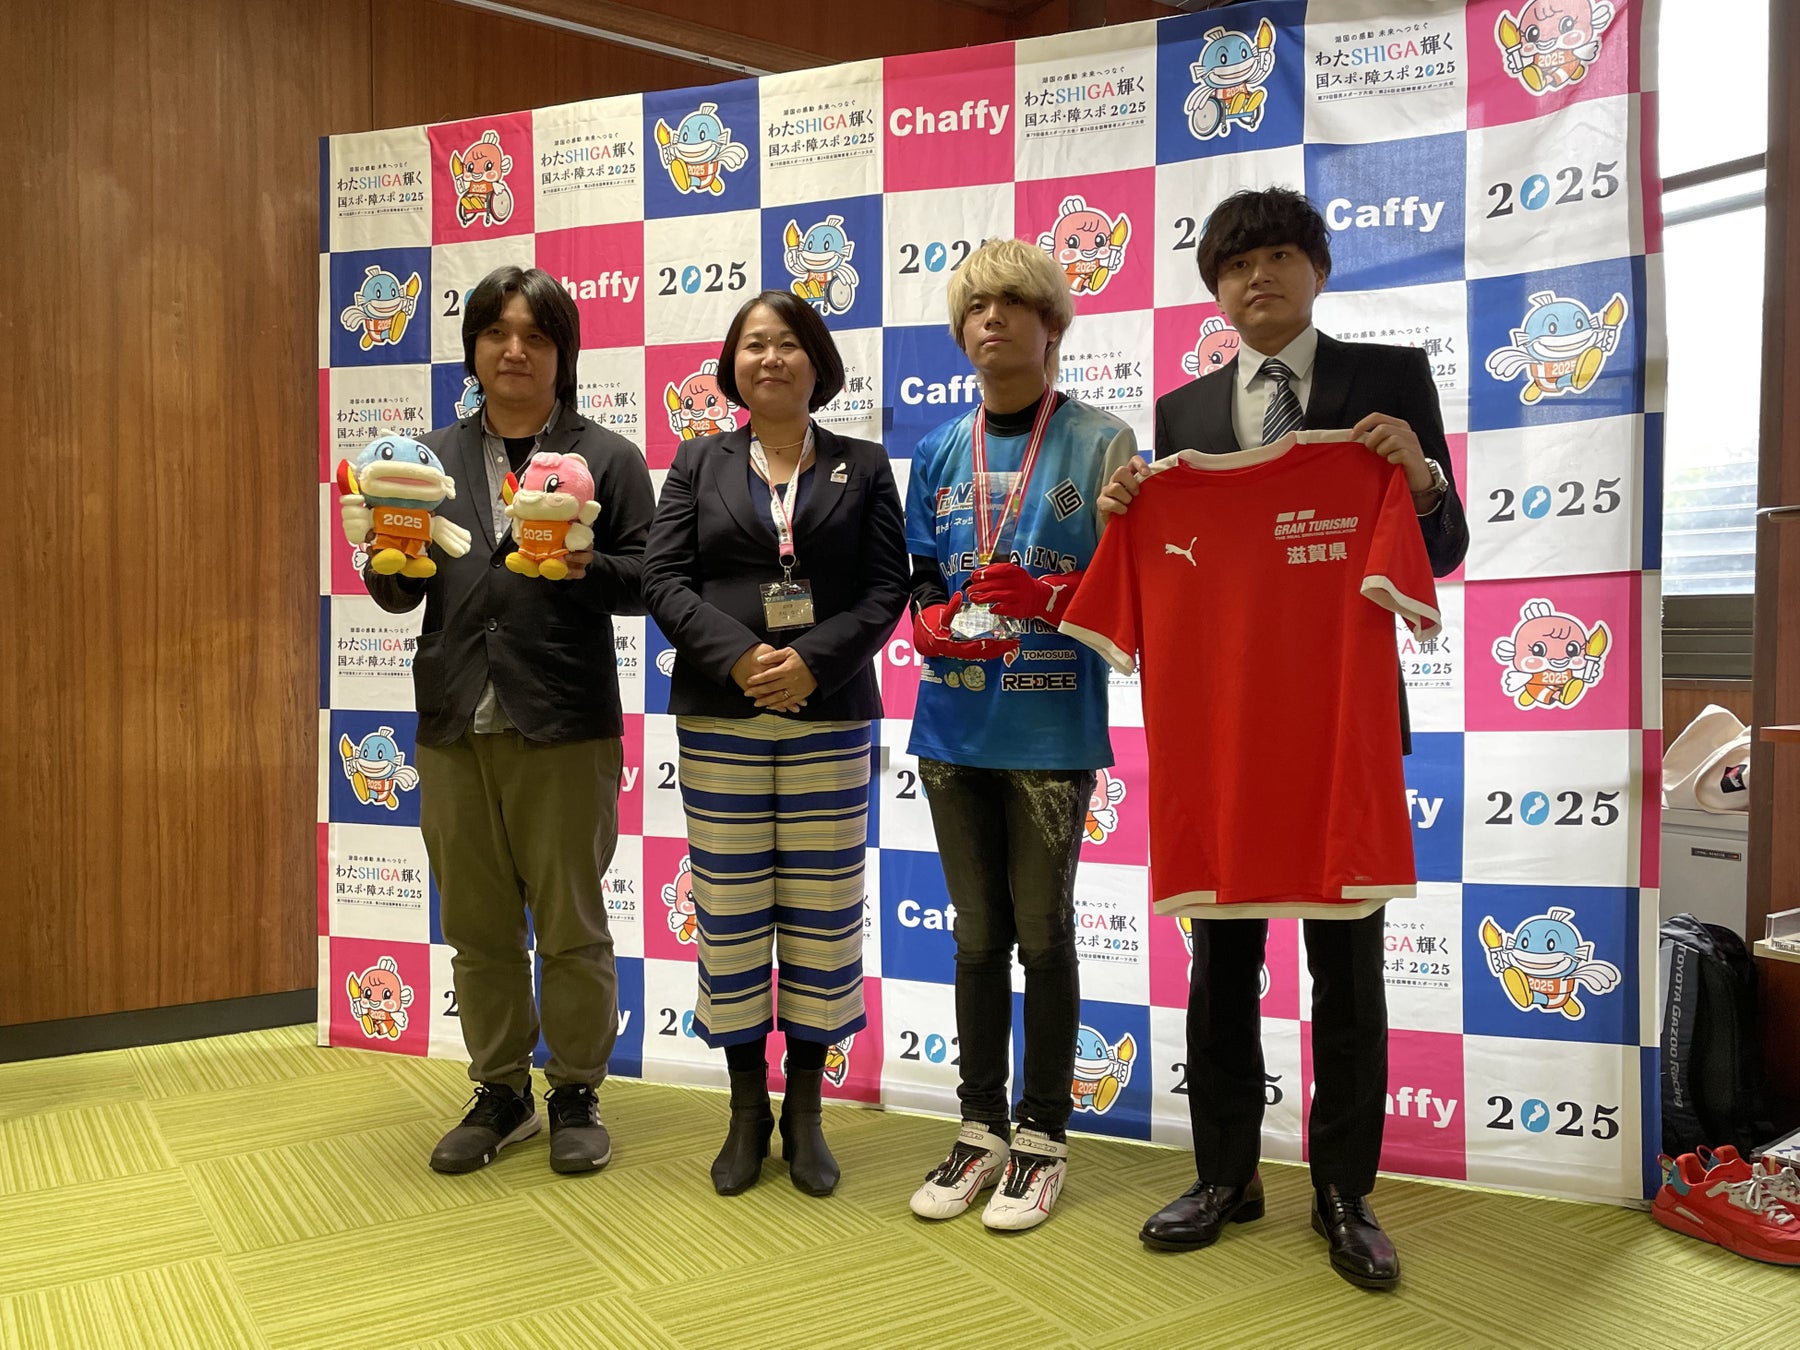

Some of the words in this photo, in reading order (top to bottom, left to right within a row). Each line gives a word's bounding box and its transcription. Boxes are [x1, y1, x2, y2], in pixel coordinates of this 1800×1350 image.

[1378, 22, 1428, 37] 未来へつなぐ
[1315, 32, 1453, 67] わたSHIGA輝く
[1538, 51, 1565, 67] 2025
[1081, 66, 1125, 78] 未来へつなぐ
[1414, 60, 1456, 79] 2025
[1024, 75, 1145, 107] わたSHIGA輝く
[1110, 101, 1147, 117] 2025
[768, 109, 874, 138] わたSHIGA輝く
[889, 99, 1010, 137] Chaffy
[843, 132, 875, 147] 2025
[541, 141, 635, 167] わたSHIGA輝く
[607, 163, 636, 176] 2025
[337, 171, 422, 191] わたSHIGA輝く
[398, 192, 424, 203] 2025
[1485, 159, 1620, 220] 2025
[1325, 195, 1445, 233] Caffy
[898, 240, 987, 275] 202
[1075, 261, 1097, 274] 2025
[560, 270, 640, 303] haffy
[657, 261, 747, 296] 2025
[1380, 326, 1430, 336] 未来へつなぐ
[1079, 351, 1122, 360] 未来へつなぐ
[1057, 362, 1142, 383] SHIGA輝く
[1108, 386, 1144, 399] 2025
[844, 399, 874, 412] 2025
[337, 406, 424, 423] わたSHIGA輝く
[609, 413, 638, 425] 2025
[1487, 477, 1621, 523] 2025
[383, 513, 423, 529] 2025
[1274, 522, 1306, 537] GRAN
[1308, 516, 1359, 532] TURISMO
[523, 528, 553, 542] 2025
[1286, 541, 1348, 565] 滋賀県
[337, 637, 417, 652] わたSHIGA輝
[617, 657, 637, 667] 025
[1022, 649, 1078, 663] TOMOSUBA
[1411, 663, 1453, 675] 2025
[1541, 670, 1569, 684] 2025
[1002, 672, 1077, 692] REDEE
[1484, 790, 1620, 826] 2025
[336, 864, 421, 883] わたSHIGA輝く
[397, 888, 422, 899] 2025
[608, 899, 635, 911] 2025
[897, 899, 958, 931] Caf
[1103, 937, 1139, 951] 2025
[1409, 961, 1450, 975] 2025
[1672, 946, 1687, 1002] TOYOTA
[1529, 978, 1555, 992] 2025
[1669, 1005, 1682, 1058] GAZOO
[1670, 1060, 1684, 1108] Racing
[1486, 1095, 1620, 1140] 2025
